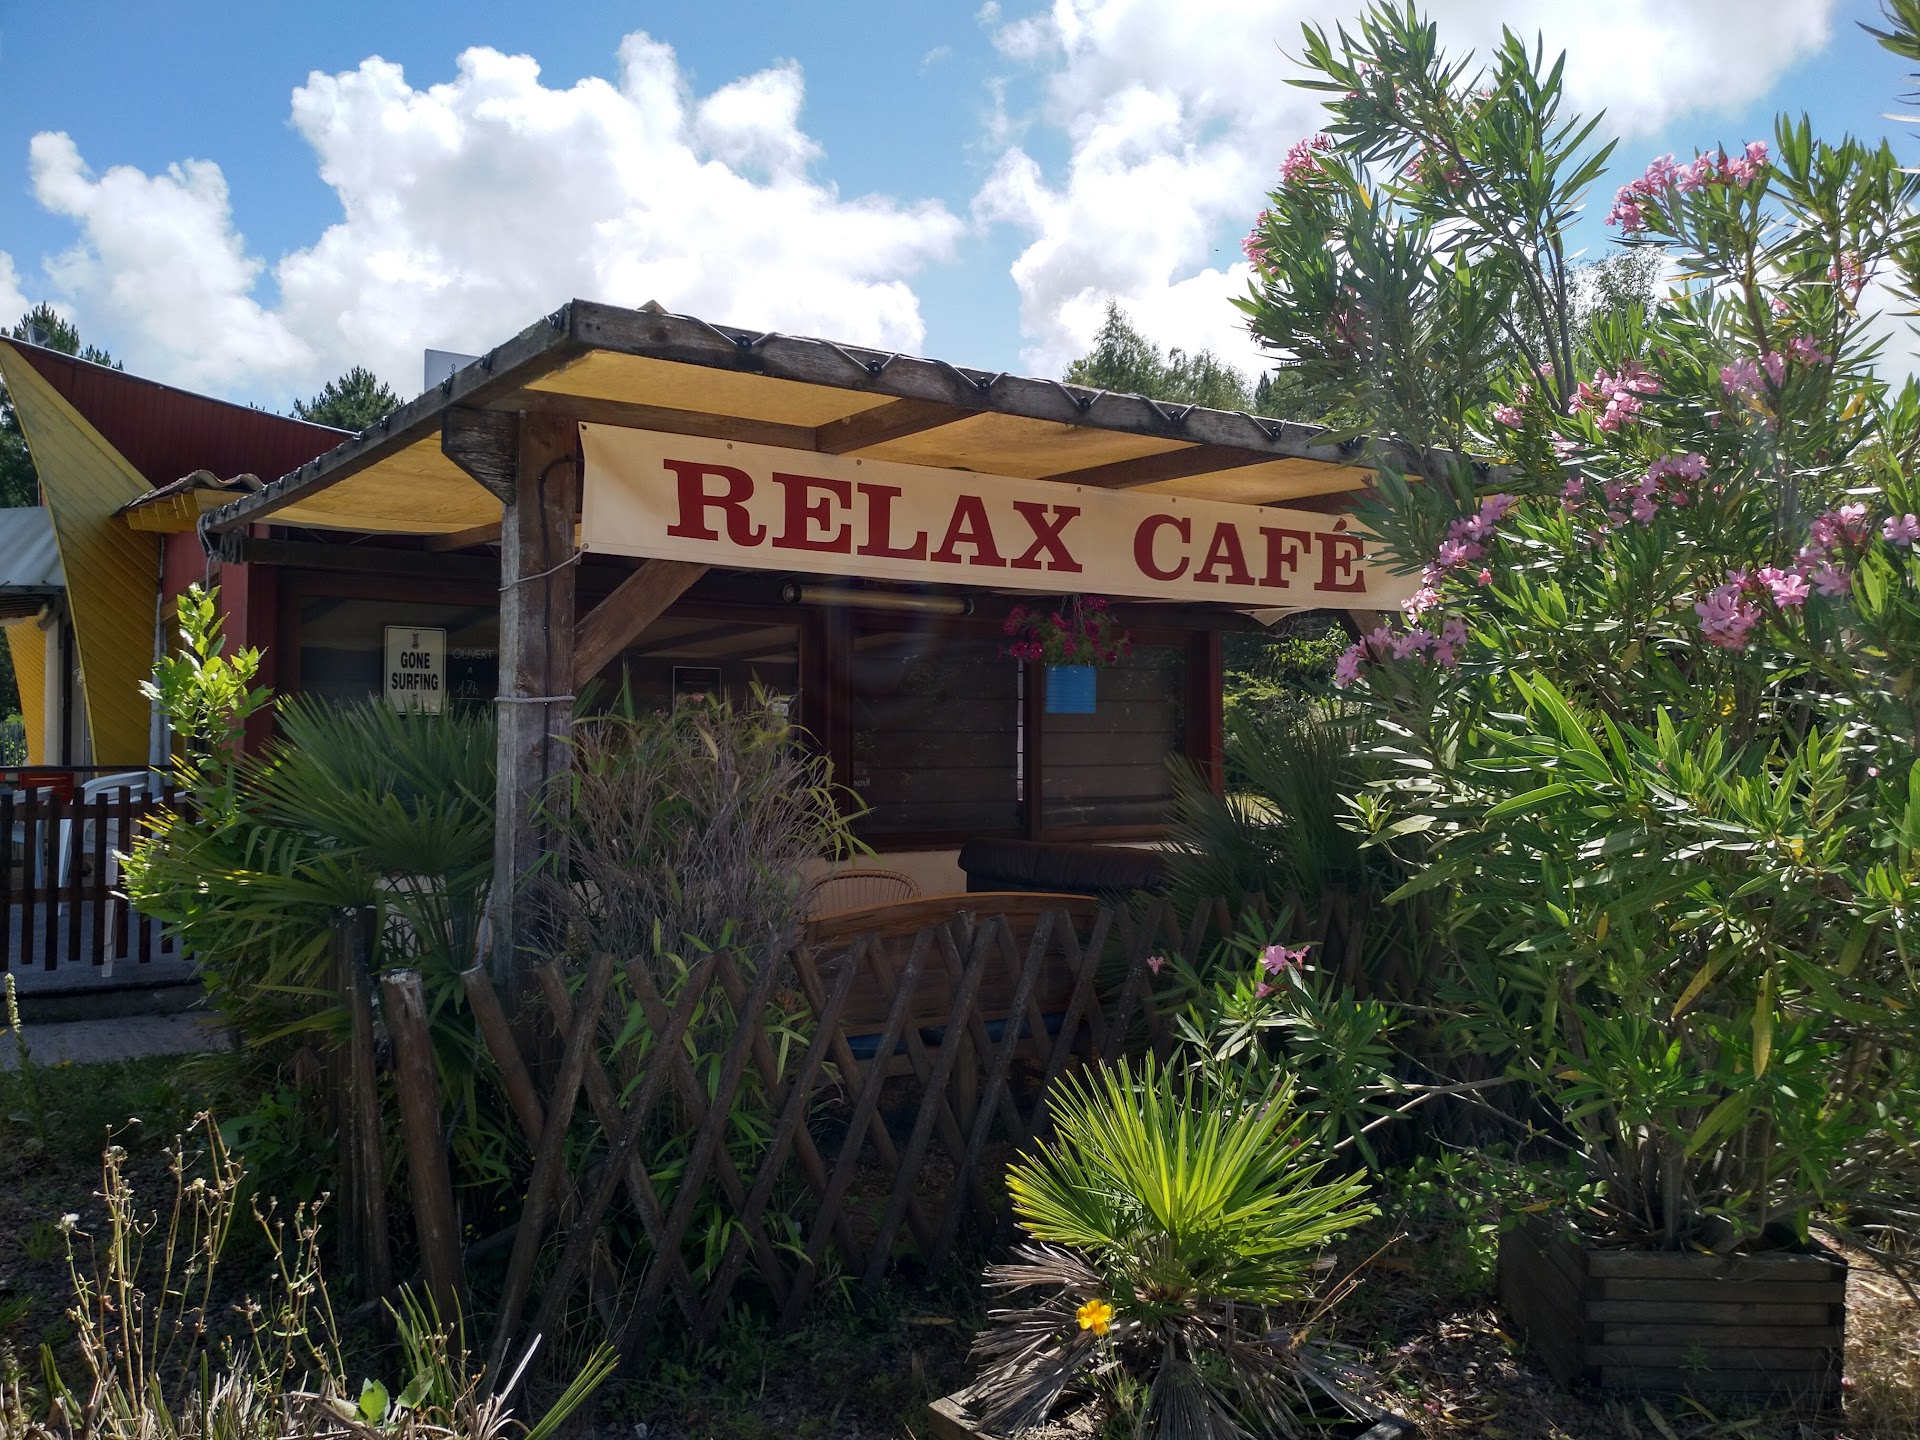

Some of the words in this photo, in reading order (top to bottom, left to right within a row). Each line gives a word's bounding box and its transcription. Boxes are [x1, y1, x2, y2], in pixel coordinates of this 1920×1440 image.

[663, 458, 1083, 573] RELAX
[1133, 513, 1367, 593] CAFÉ
[401, 651, 430, 669] GONE
[452, 648, 494, 660] OUVERT
[392, 672, 438, 691] SURFING
